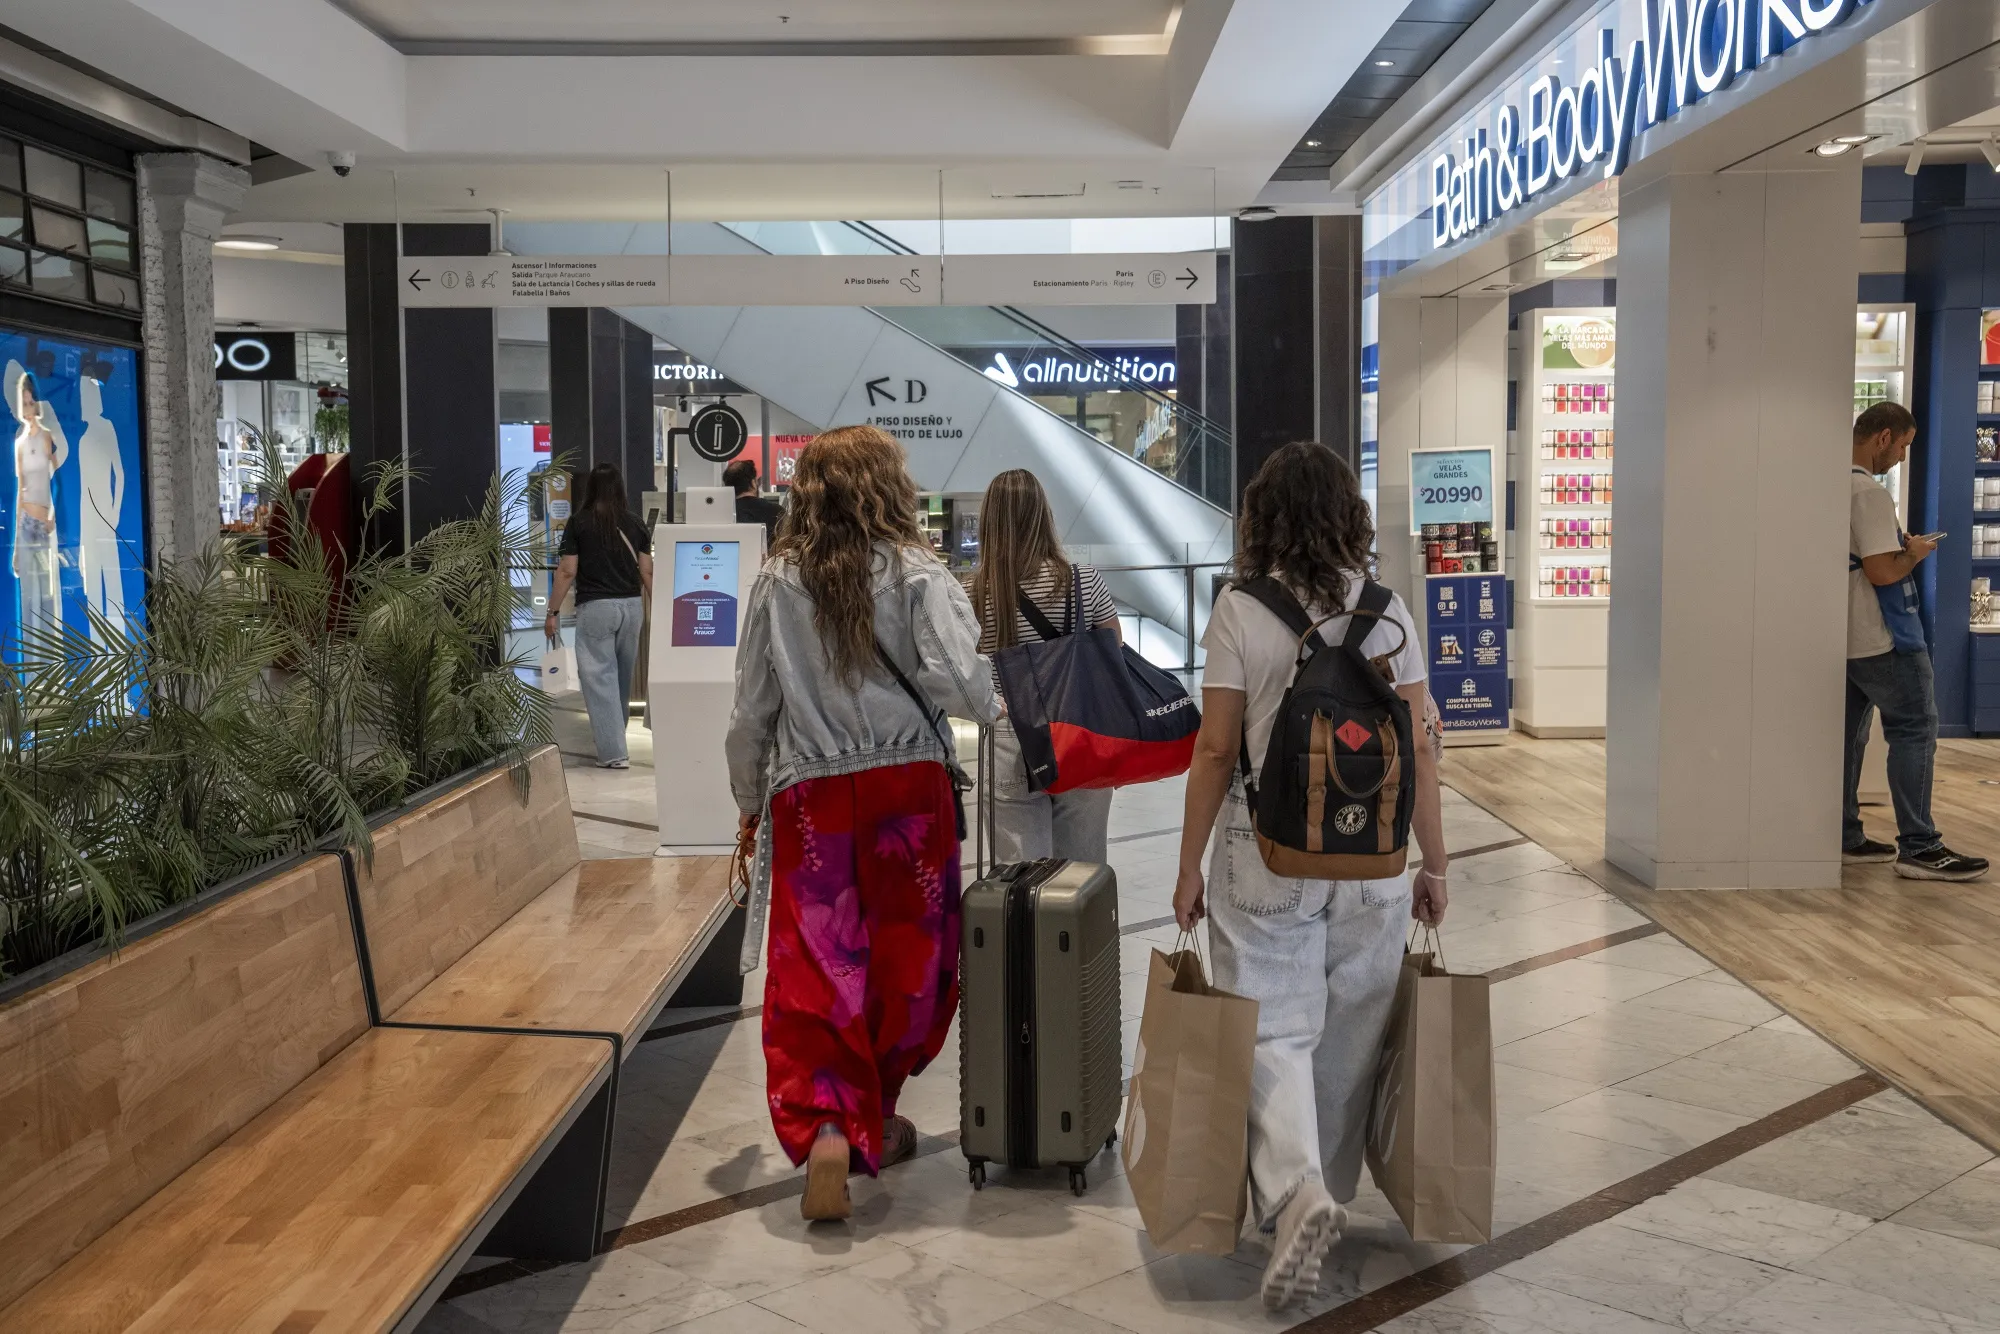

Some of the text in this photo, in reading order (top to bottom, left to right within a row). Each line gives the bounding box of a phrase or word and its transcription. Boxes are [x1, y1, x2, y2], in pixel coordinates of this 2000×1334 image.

[548, 261, 597, 269] Informaciones
[534, 271, 558, 279] Parque
[866, 277, 890, 285] Diseño
[1113, 279, 1134, 288] Ripley
[1559, 326, 1569, 334] LA
[1570, 326, 1598, 334] MARCA
[1578, 341, 1607, 349] MUNDO
[1023, 356, 1176, 383] allnutrition
[904, 379, 927, 404] D
[875, 416, 900, 426] PISO
[902, 414, 943, 426] DISEÑO
[945, 416, 953, 425] Y
[918, 429, 932, 439] DE
[935, 429, 963, 439] LUJO
[775, 434, 799, 443] NUEVA
[1438, 464, 1462, 472] VELAS
[1433, 471, 1468, 479] GRANDES
